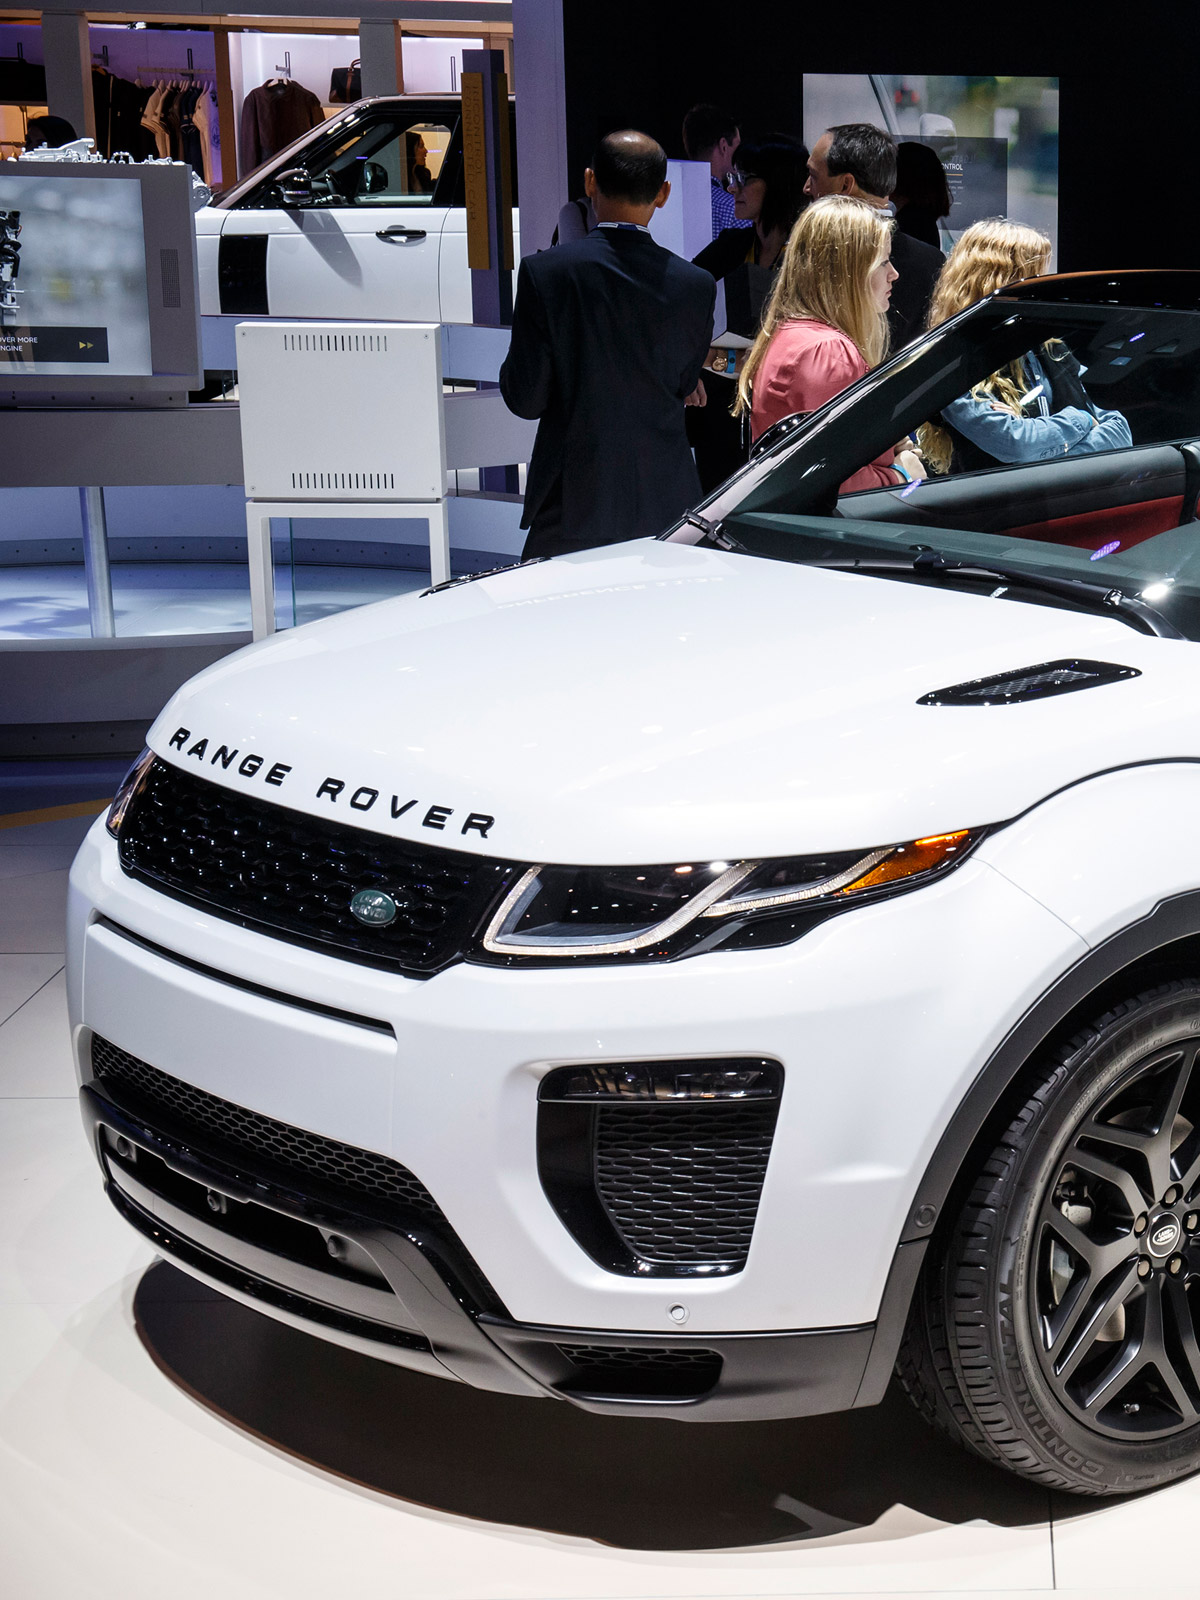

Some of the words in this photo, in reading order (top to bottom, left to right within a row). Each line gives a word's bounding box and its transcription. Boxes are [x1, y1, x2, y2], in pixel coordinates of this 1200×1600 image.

[17, 336, 38, 344] MORE
[168, 727, 293, 786] RANGE
[316, 777, 495, 838] ROVER
[999, 1269, 1105, 1478] CONTINENTAL
